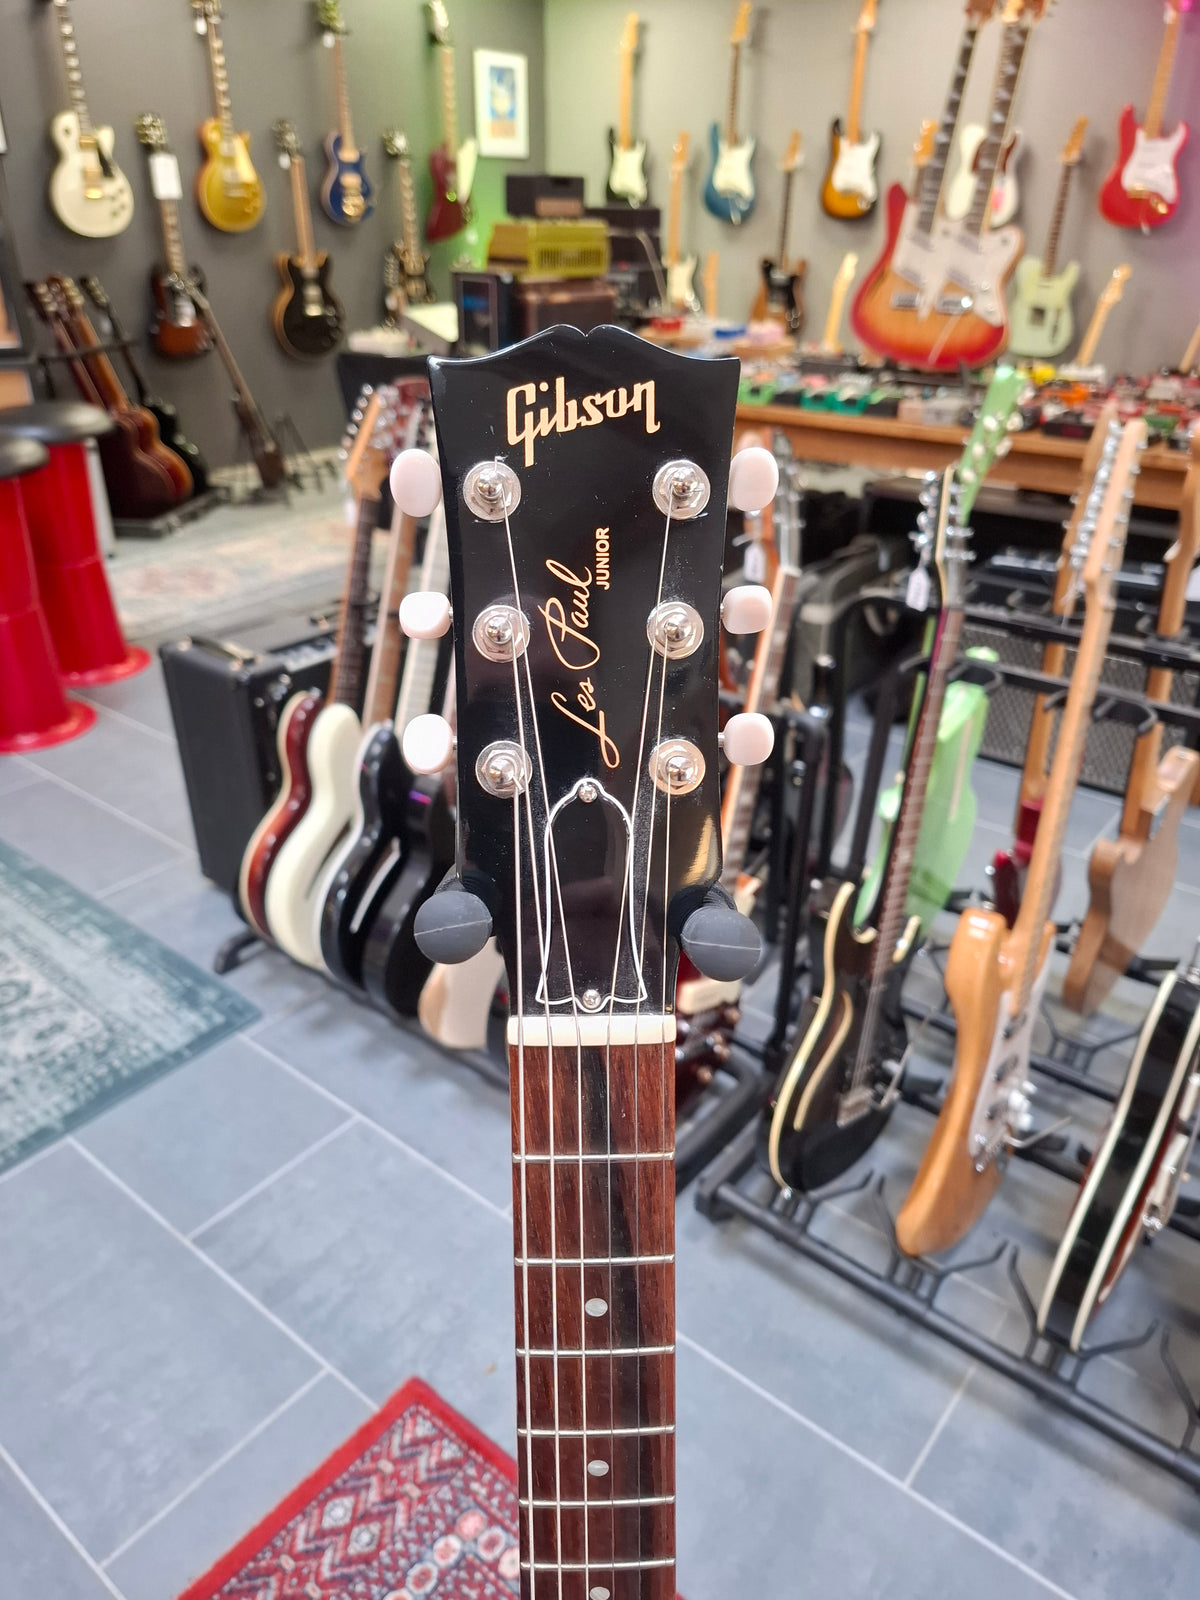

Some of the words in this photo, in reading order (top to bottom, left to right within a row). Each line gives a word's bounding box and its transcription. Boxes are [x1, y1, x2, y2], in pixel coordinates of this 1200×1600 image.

[506, 376, 661, 467] Gibson
[595, 526, 610, 591] JUNIOR
[537, 558, 601, 671] Paul
[550, 676, 620, 769] Les
